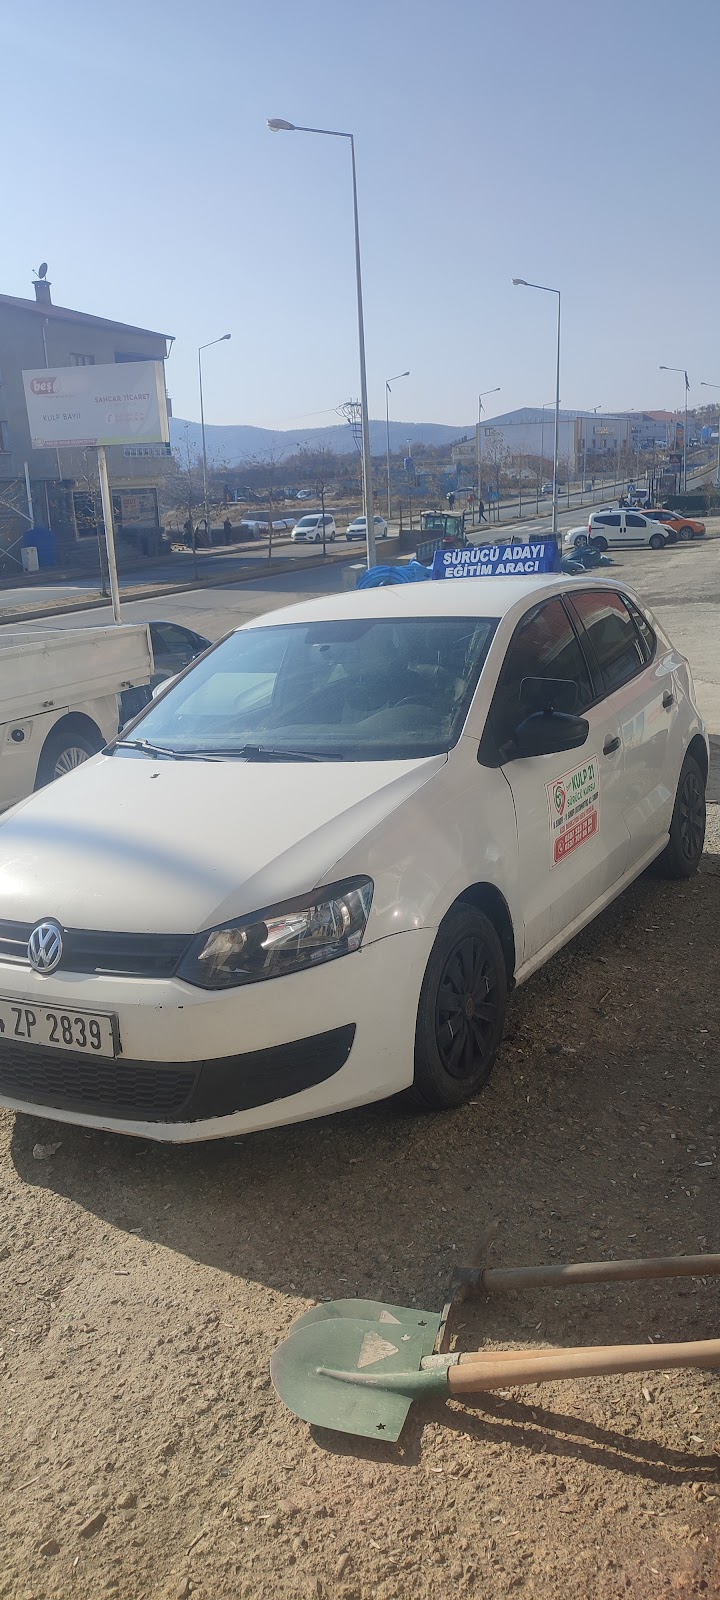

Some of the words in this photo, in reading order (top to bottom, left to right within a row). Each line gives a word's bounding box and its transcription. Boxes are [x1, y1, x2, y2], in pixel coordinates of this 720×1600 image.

[42, 413, 60, 422] KULP
[442, 546, 500, 565] SÜRÜCÜ
[502, 544, 545, 561] ADAYI
[444, 562, 493, 578] EĞİTİM
[495, 560, 540, 574] ARACI
[571, 768, 588, 790] KULP
[588, 764, 595, 780] 21
[11, 1007, 37, 1038] ZP
[45, 1013, 102, 1050] 2839
